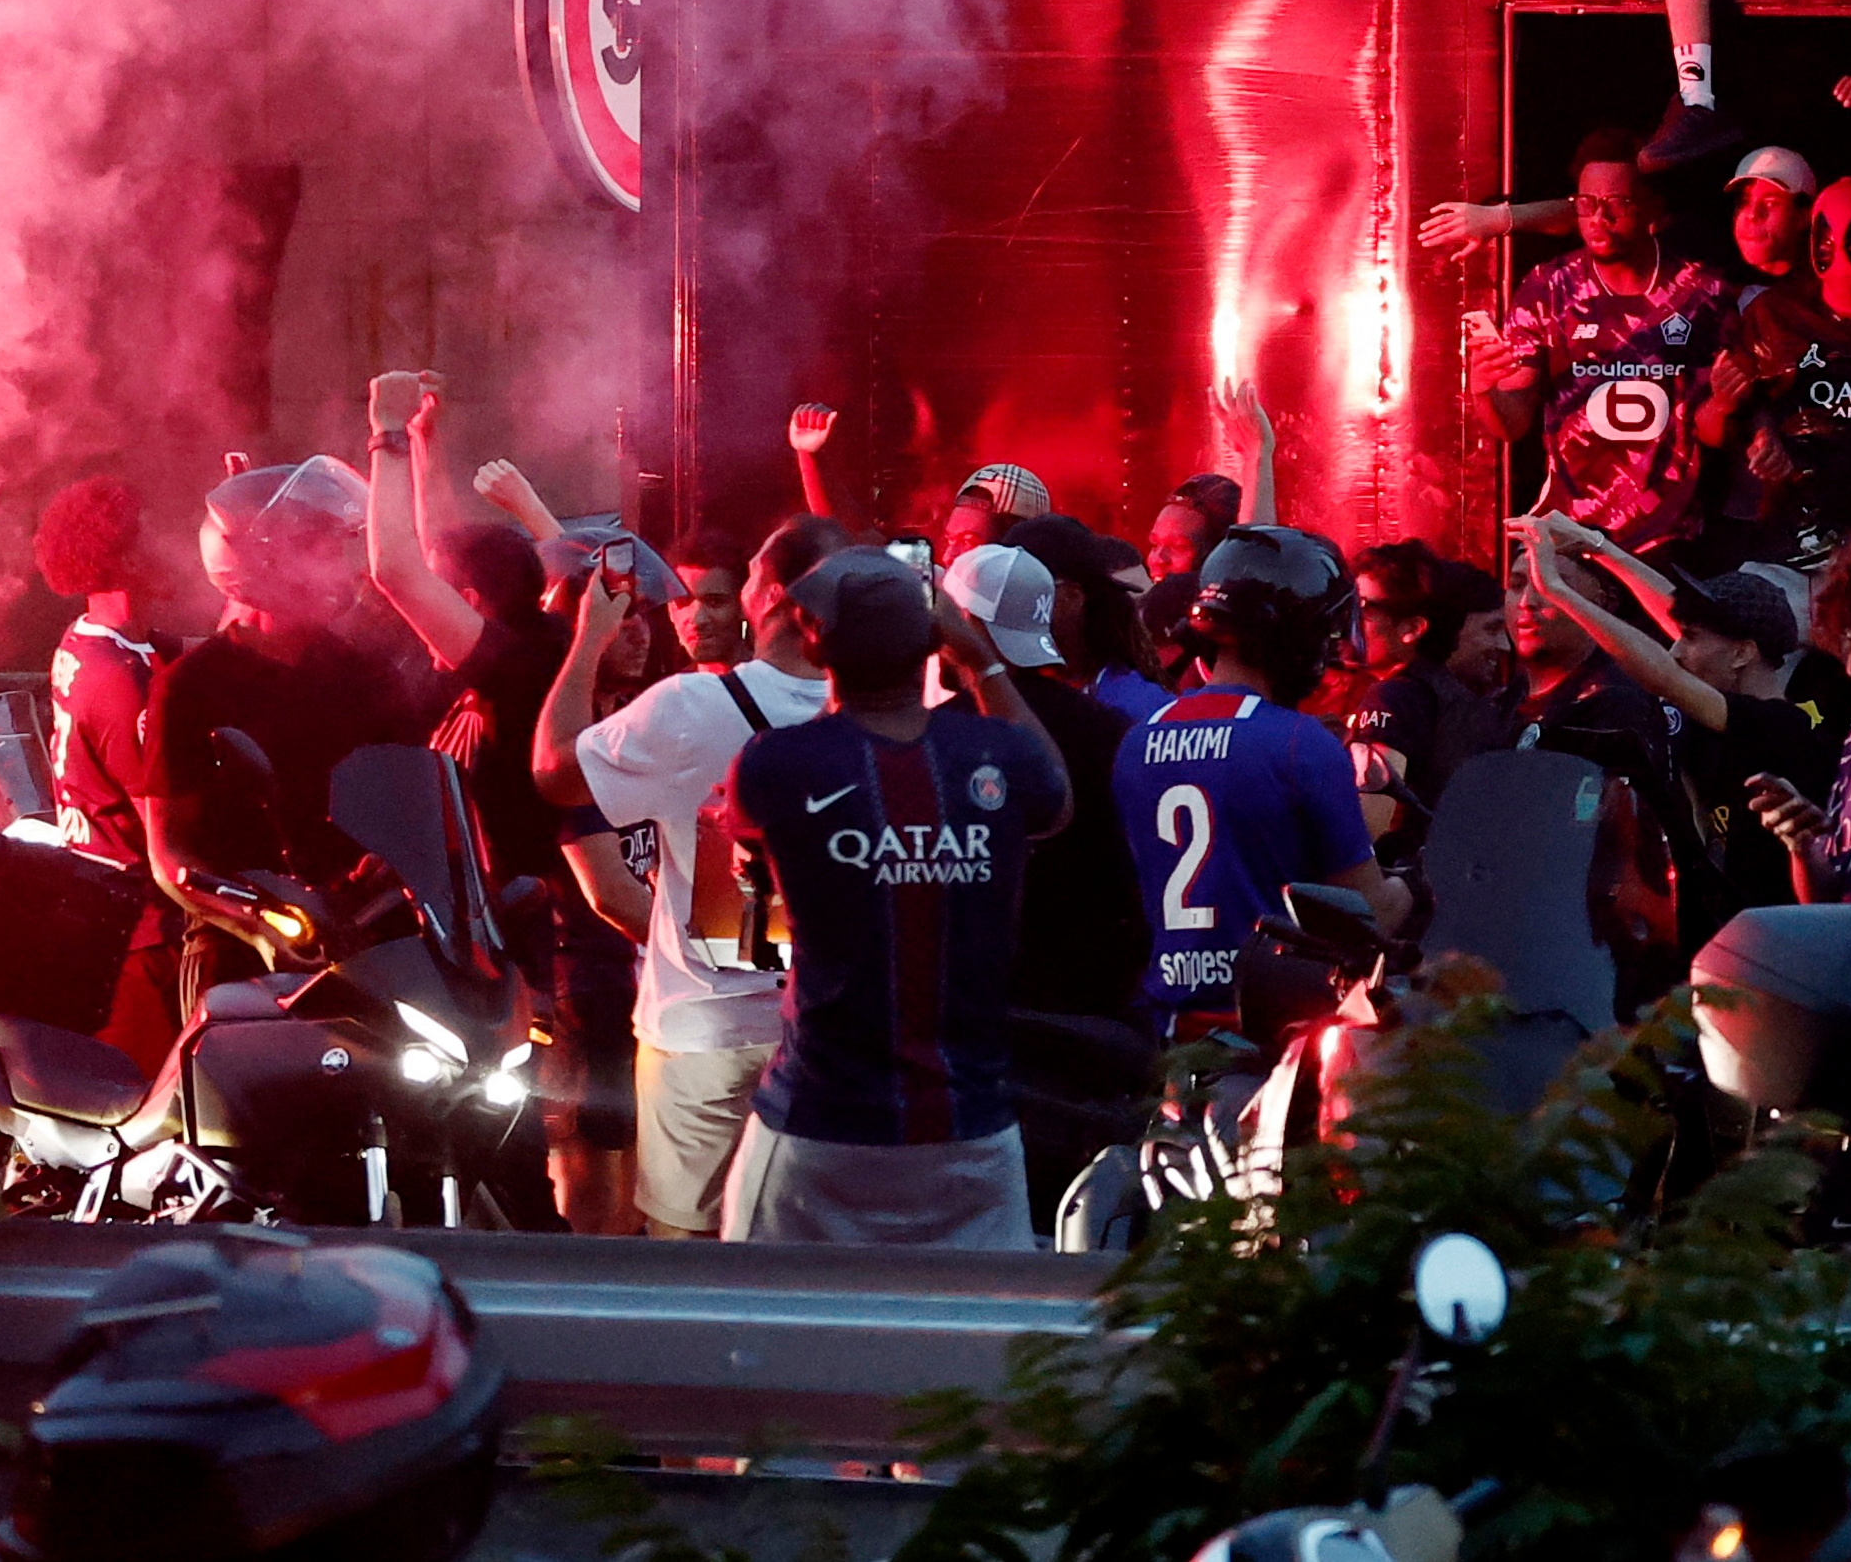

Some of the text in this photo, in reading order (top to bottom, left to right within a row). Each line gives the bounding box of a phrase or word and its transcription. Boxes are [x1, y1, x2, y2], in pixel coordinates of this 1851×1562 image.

[1572, 361, 1686, 380] boulanger
[1144, 725, 1233, 765] HAKIMI
[827, 824, 991, 870] QATAR
[1157, 784, 1216, 931] 2
[875, 860, 992, 885] AIRWAYS
